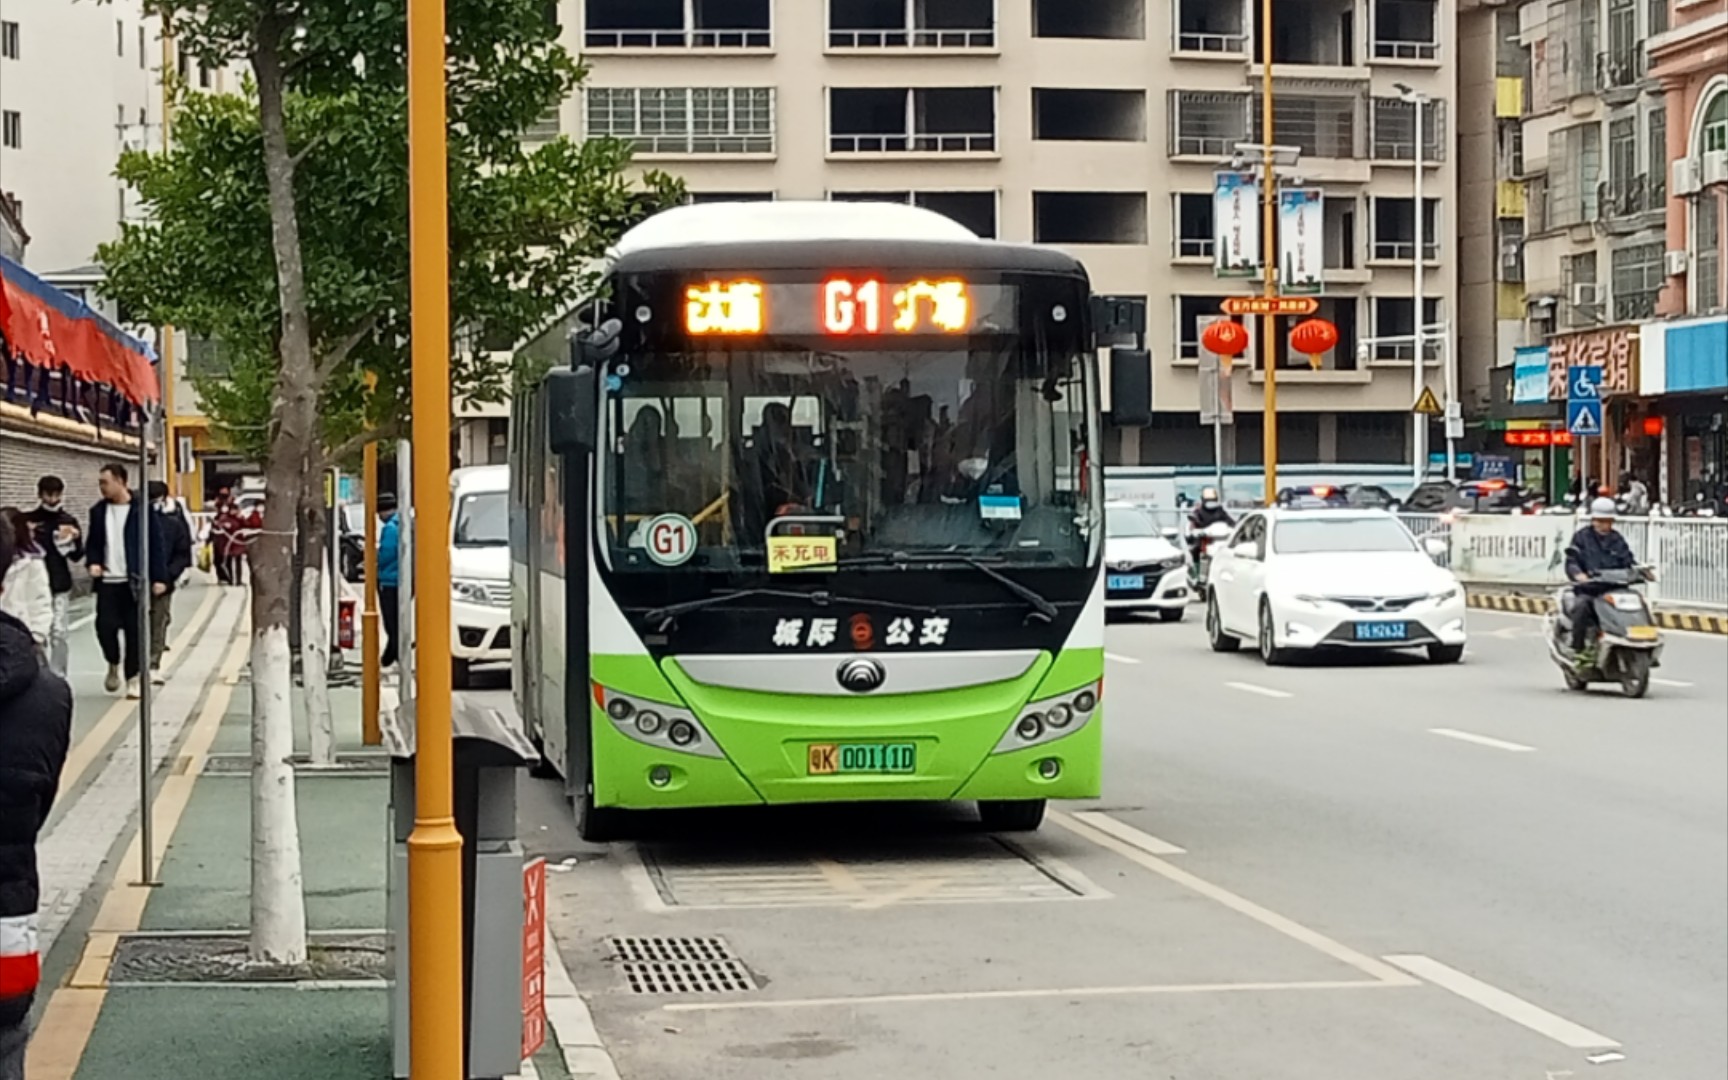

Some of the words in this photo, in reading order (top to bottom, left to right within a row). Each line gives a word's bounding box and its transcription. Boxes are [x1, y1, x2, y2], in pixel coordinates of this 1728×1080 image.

[824, 280, 878, 332] G1
[653, 523, 686, 555] G1
[885, 616, 950, 646] 公交
